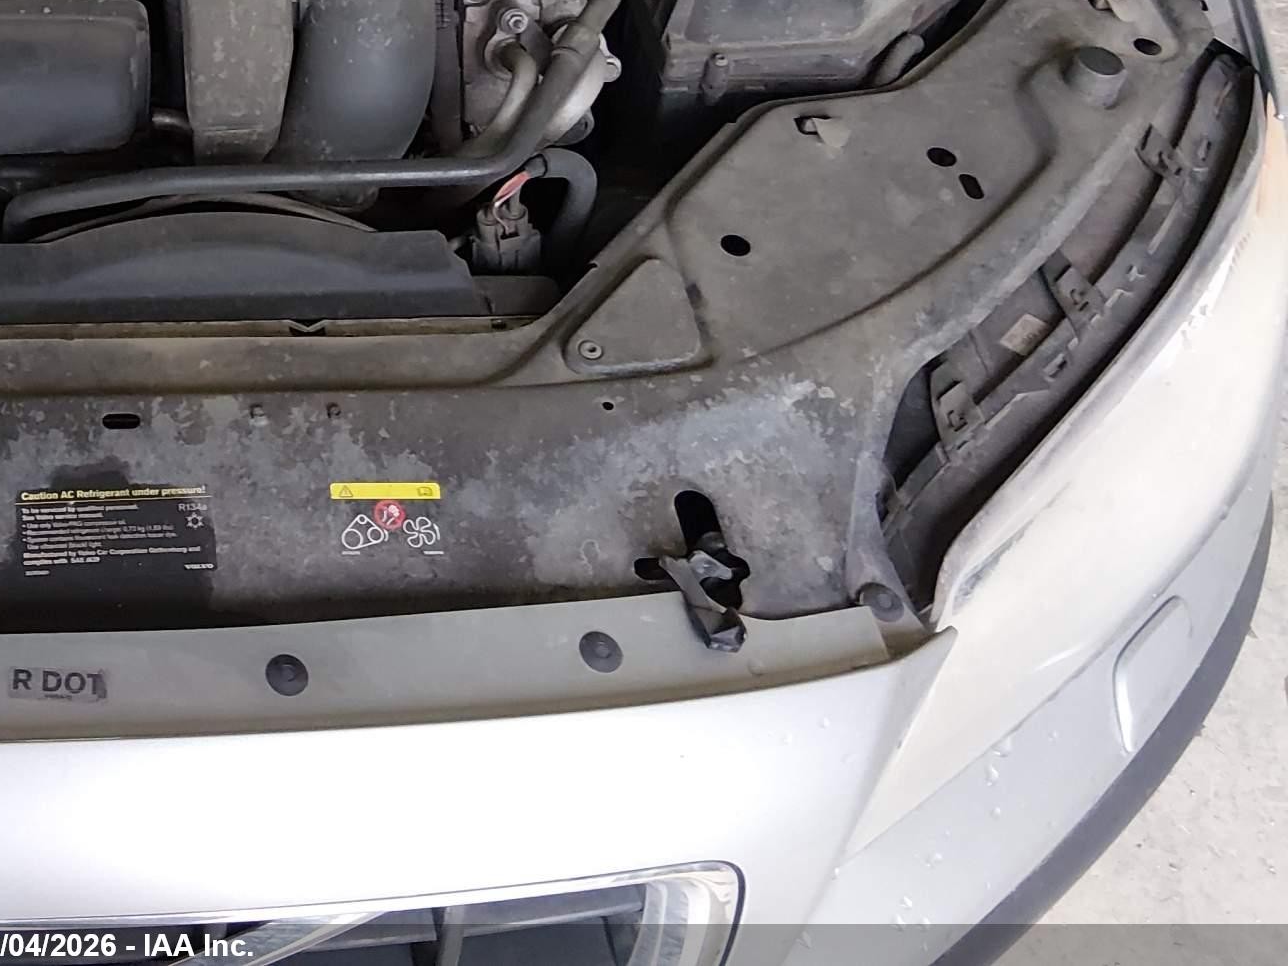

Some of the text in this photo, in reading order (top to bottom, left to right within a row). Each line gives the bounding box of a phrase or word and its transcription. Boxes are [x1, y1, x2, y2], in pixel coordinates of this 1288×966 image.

[21, 484, 207, 501] Caution AC Refrigerant under pressure!
[177, 502, 209, 512] R134a
[11, 668, 104, 695] R DOT
